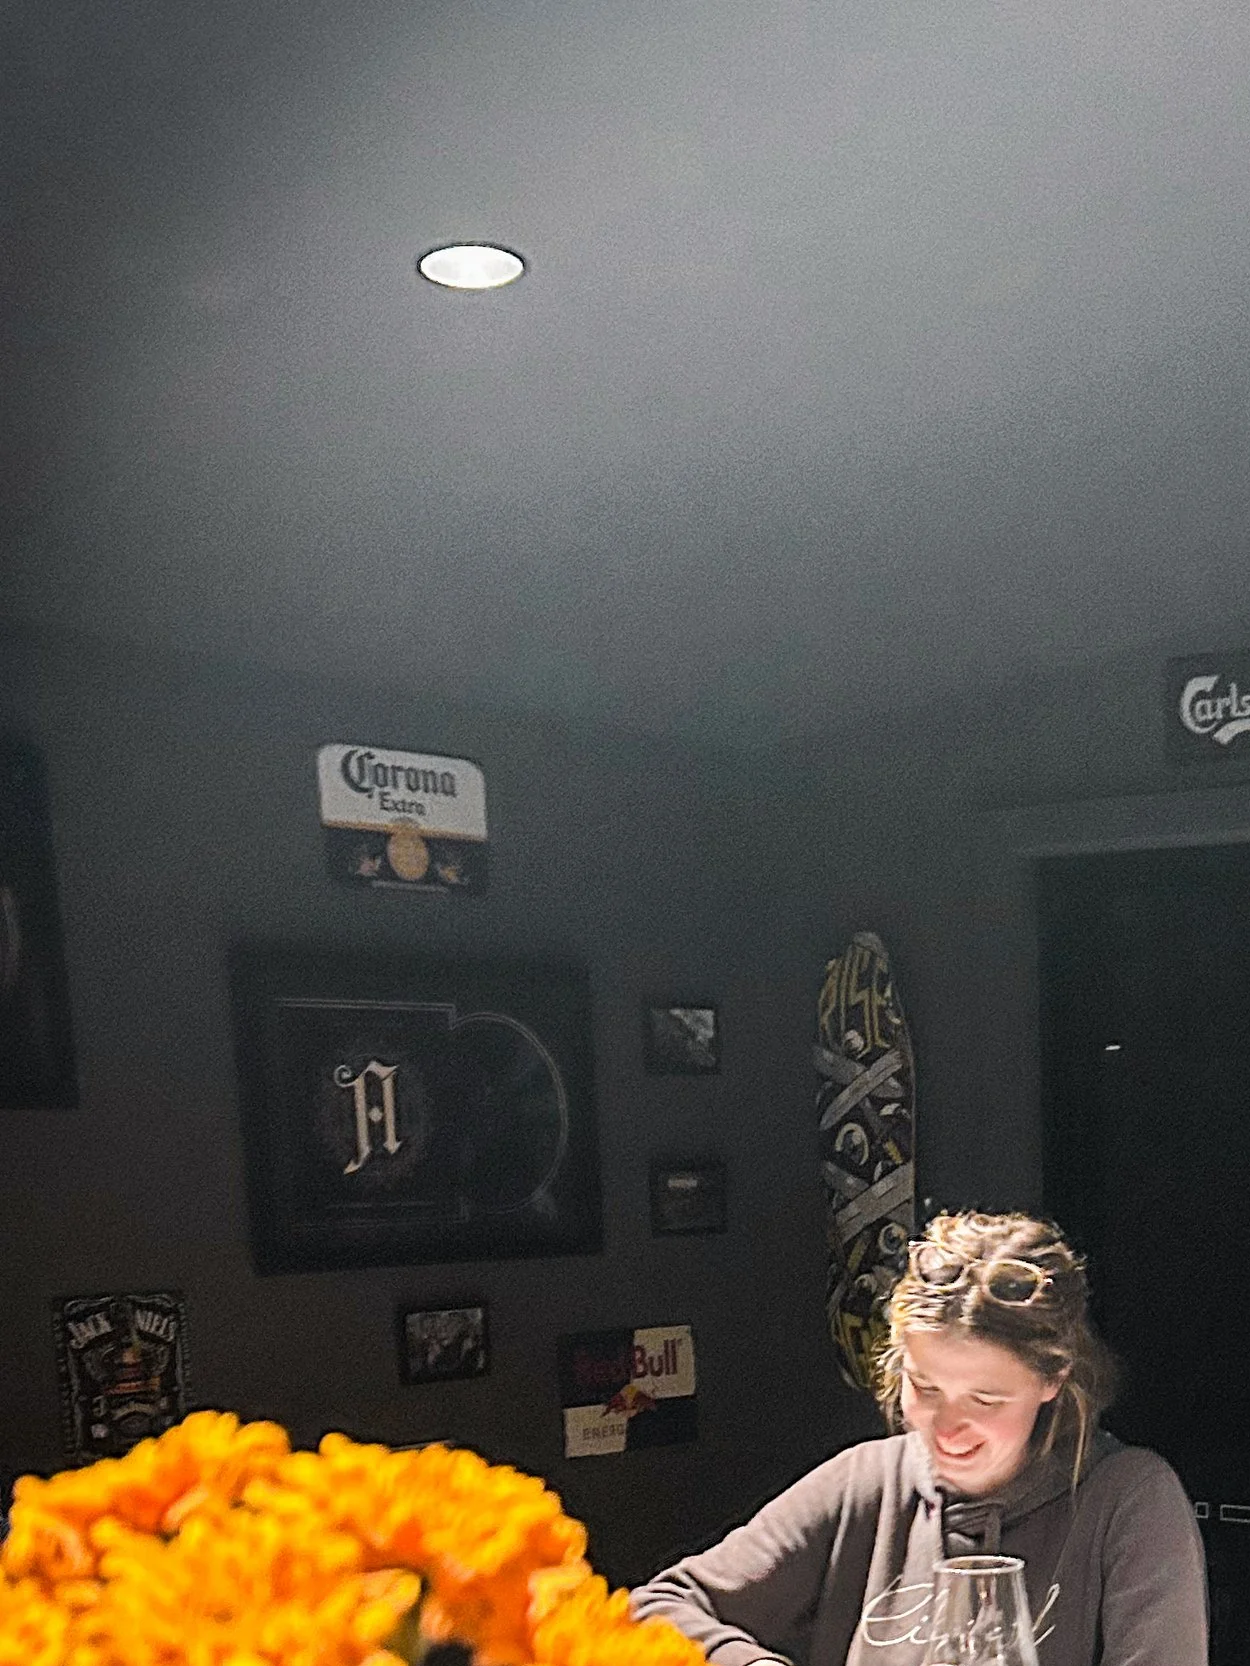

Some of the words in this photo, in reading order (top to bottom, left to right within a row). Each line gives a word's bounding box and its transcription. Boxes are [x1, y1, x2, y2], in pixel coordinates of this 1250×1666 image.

[341, 750, 458, 799] Corona
[379, 791, 427, 816] Extra
[67, 1311, 114, 1349] JACK
[632, 1338, 678, 1379] Bull
